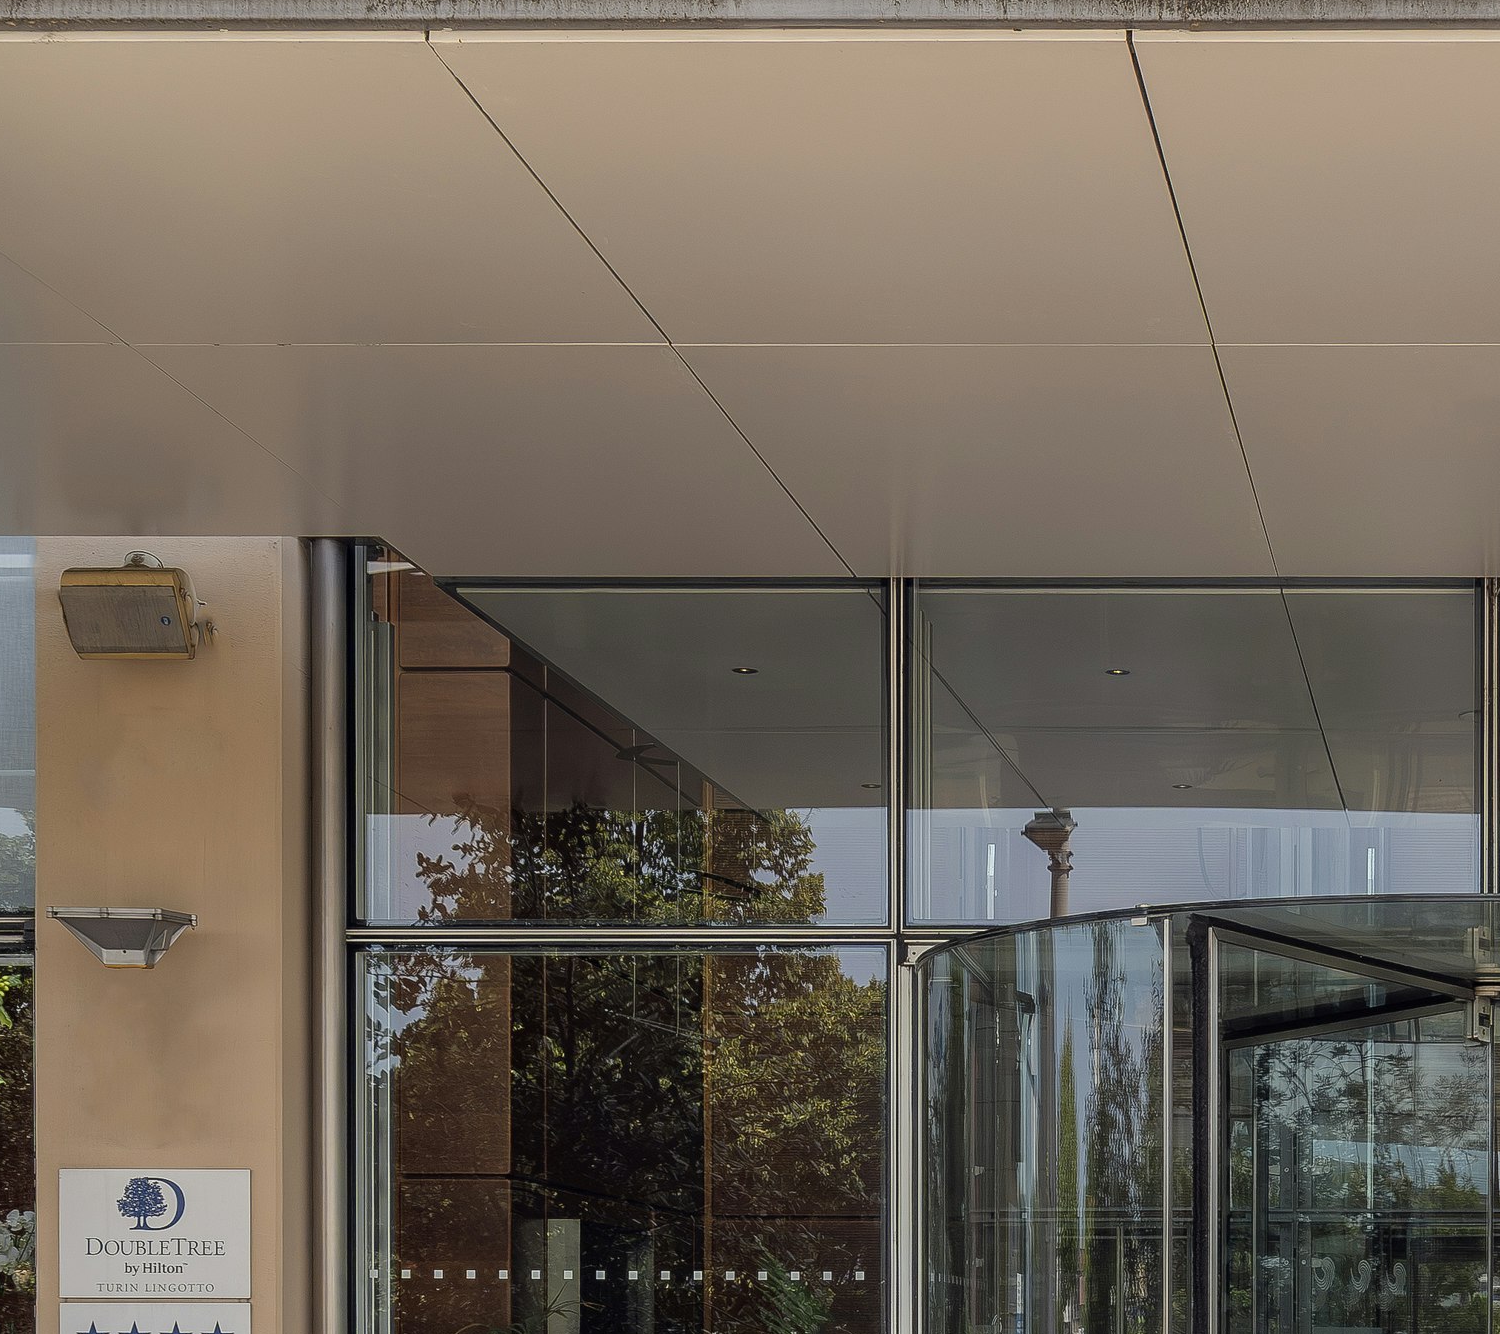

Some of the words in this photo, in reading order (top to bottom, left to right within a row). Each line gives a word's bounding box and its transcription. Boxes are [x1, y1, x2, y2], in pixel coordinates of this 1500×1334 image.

[124, 1262, 140, 1277] by
[96, 1283, 139, 1293] TURIN
[145, 1283, 215, 1293] LINGOTTO
